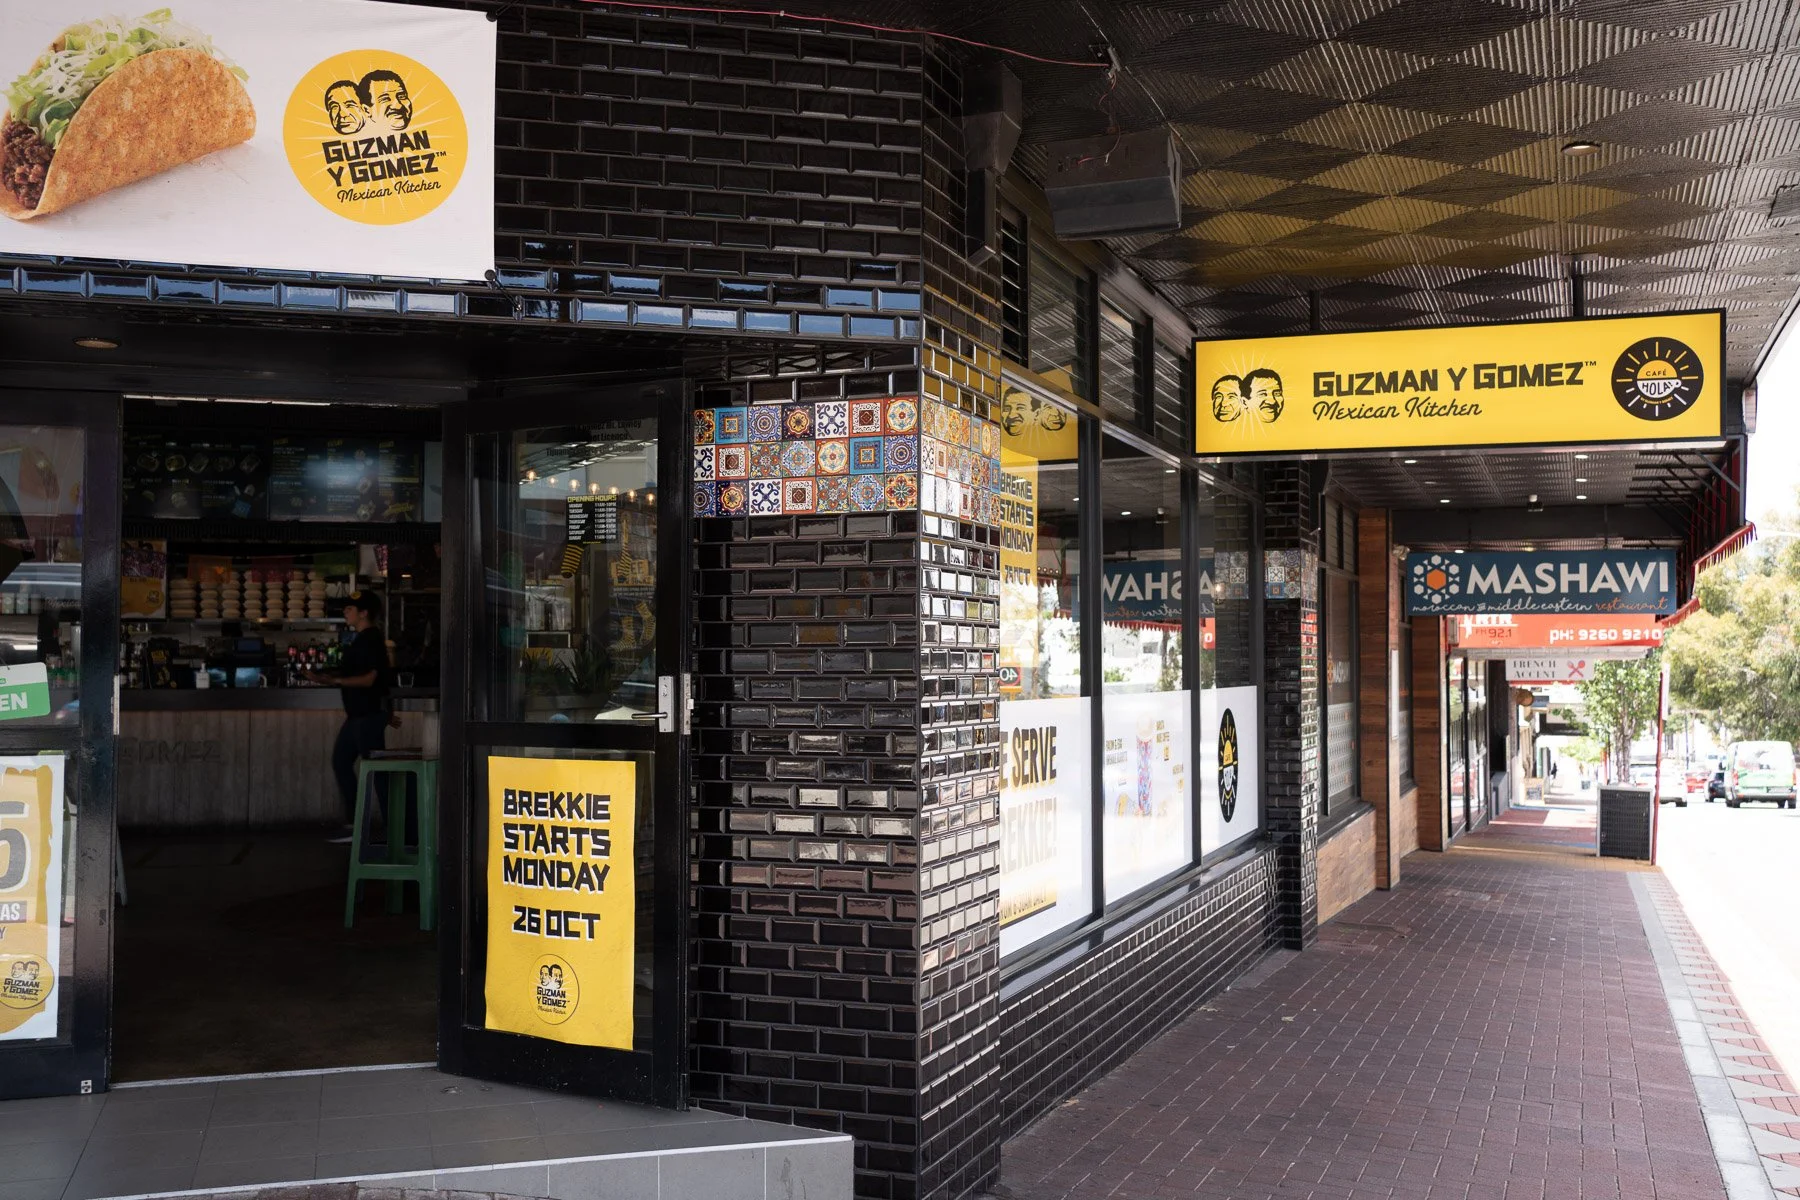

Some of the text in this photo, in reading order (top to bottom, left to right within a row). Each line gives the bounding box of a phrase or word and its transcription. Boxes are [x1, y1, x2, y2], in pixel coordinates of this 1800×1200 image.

[322, 130, 431, 164] GUZMAN
[327, 166, 345, 188] Y
[337, 180, 442, 203] Mexican Kitchen
[1313, 368, 1439, 397] GUZMAN
[1446, 366, 1468, 391] Y
[1645, 369, 1667, 377] CAFÉ
[1313, 396, 1483, 421] Mexican Kitchen
[567, 494, 617, 503] OPENING HOURS
[1466, 561, 1669, 595] MASHAWI
[1488, 628, 1512, 638] 92.1
[1578, 628, 1618, 641] 9260
[1622, 628, 1662, 641] 9210
[1012, 726, 1057, 788] SERVE
[503, 788, 611, 822] BREKKIE
[503, 822, 611, 858] STARTS
[503, 855, 611, 894] MONDAY
[512, 904, 601, 942] 26 OCT
[536, 986, 566, 999] GUZMAN
